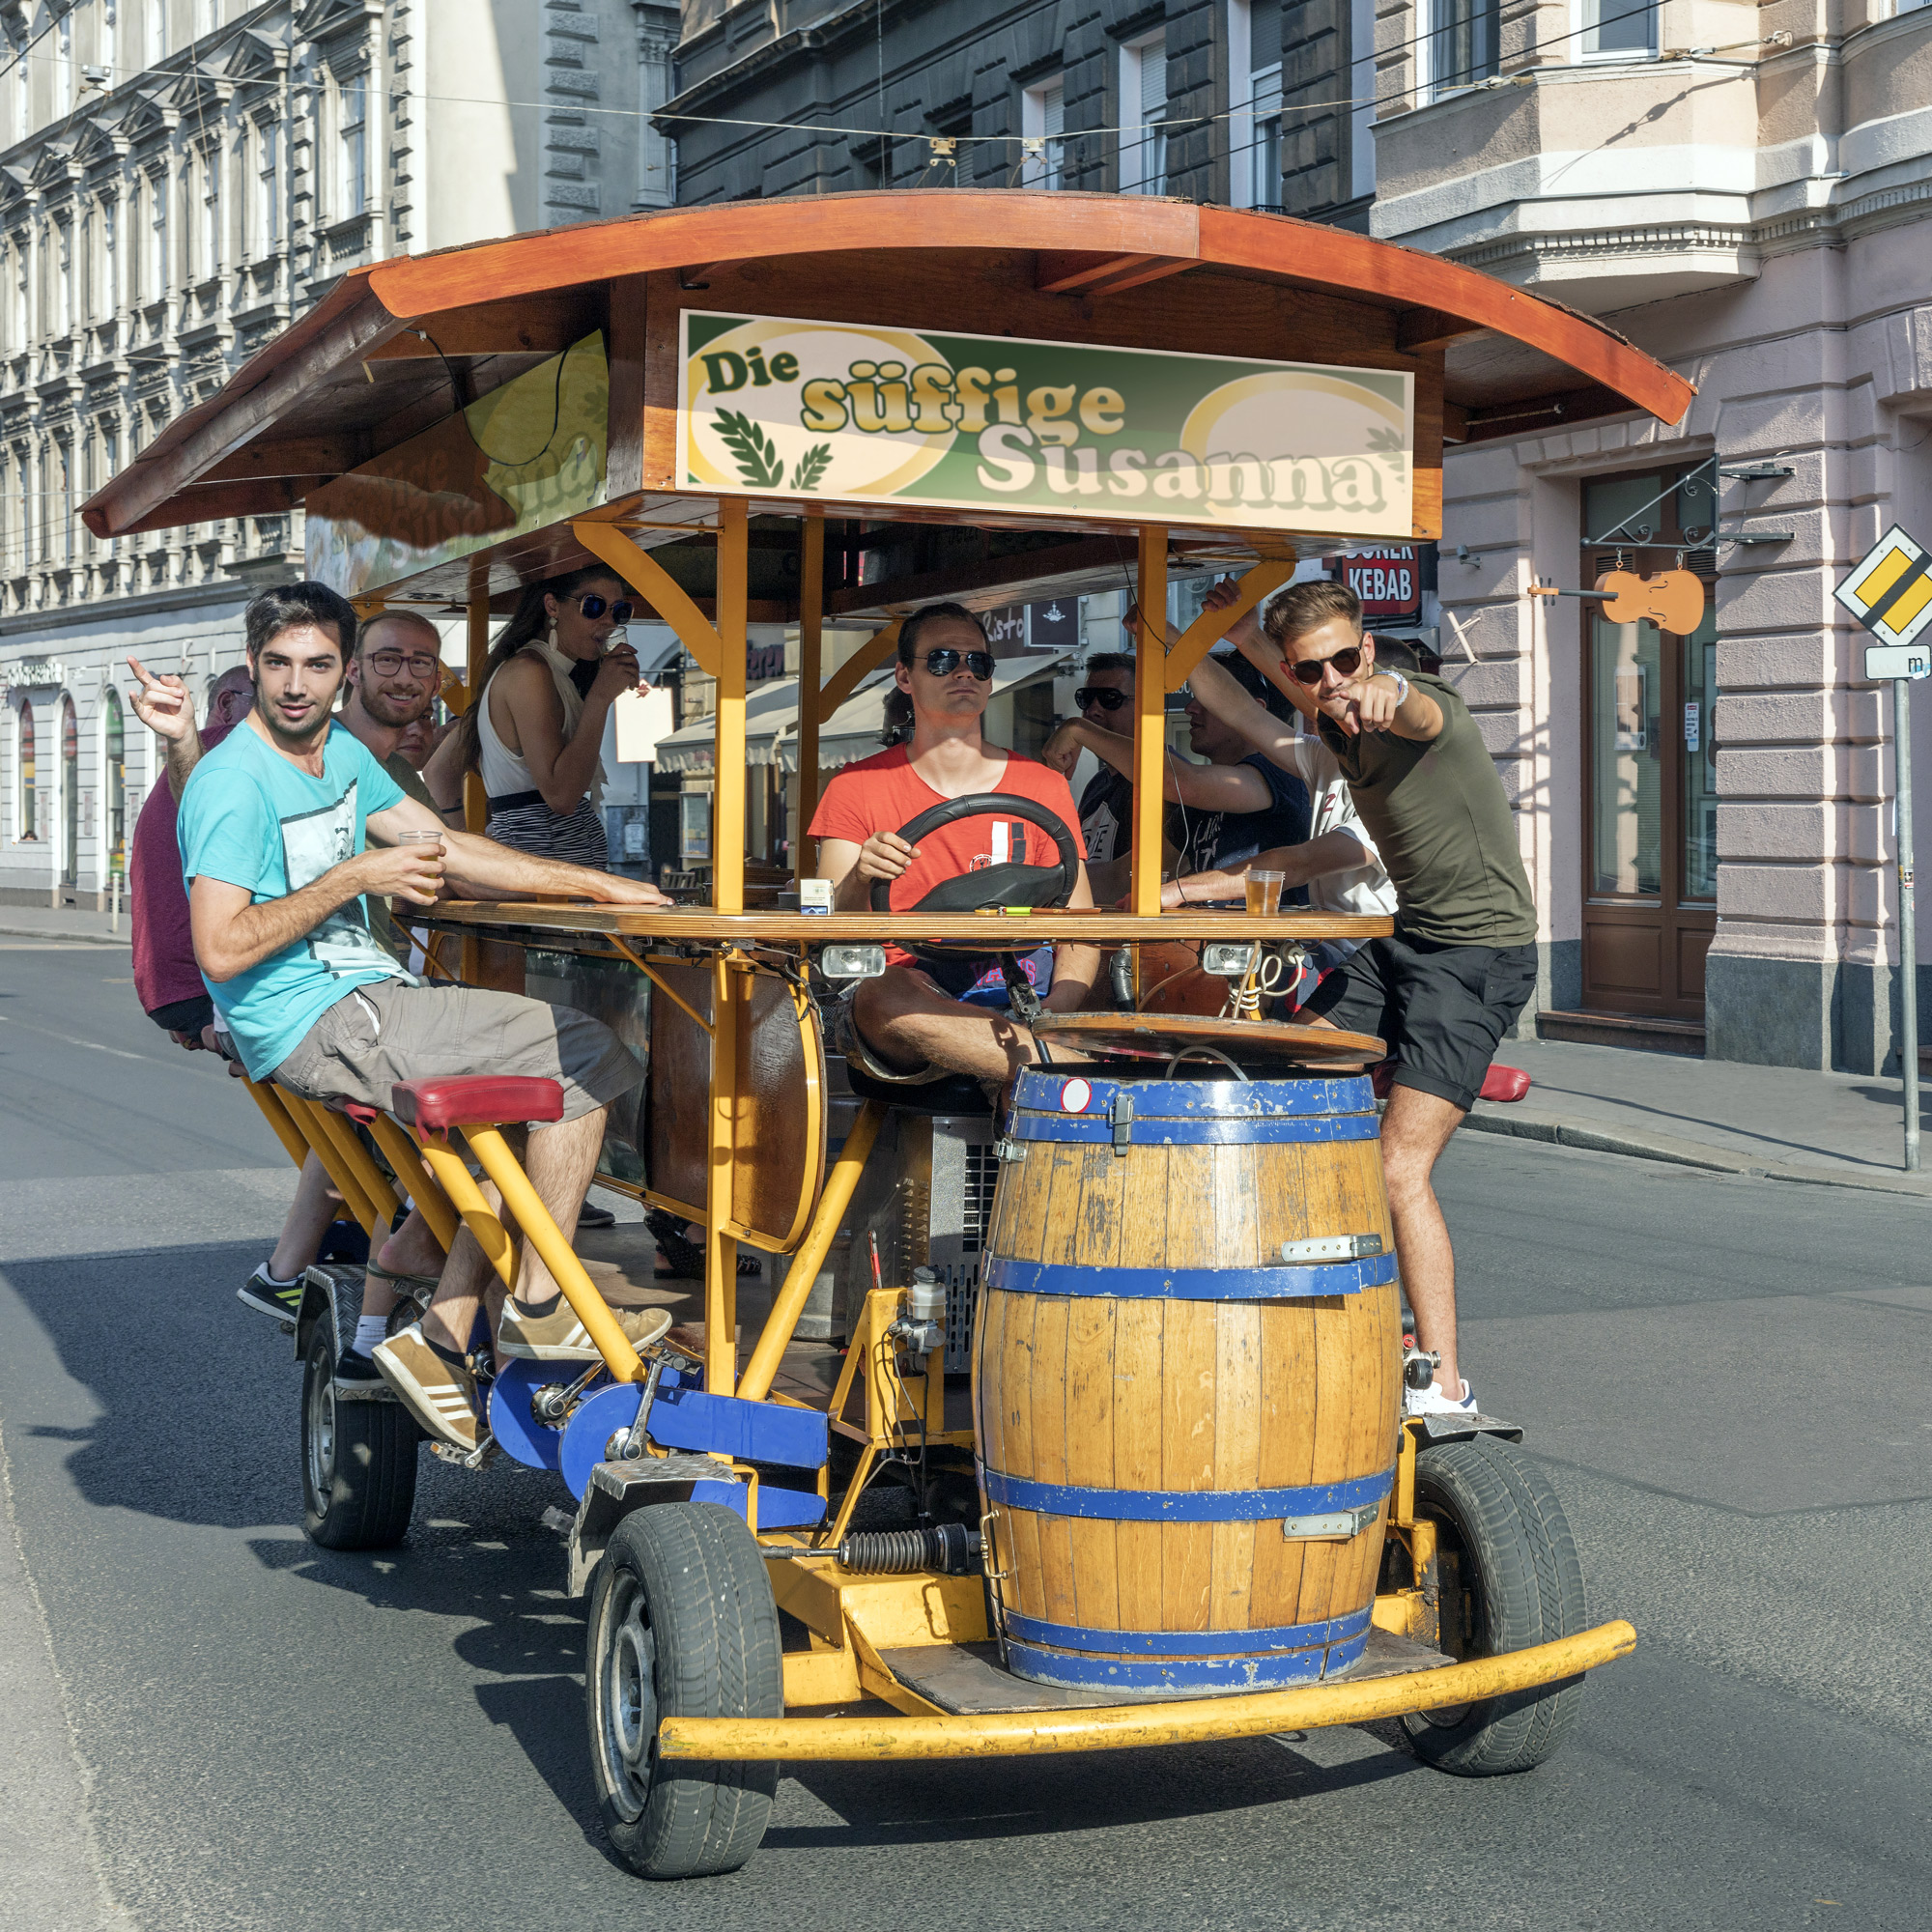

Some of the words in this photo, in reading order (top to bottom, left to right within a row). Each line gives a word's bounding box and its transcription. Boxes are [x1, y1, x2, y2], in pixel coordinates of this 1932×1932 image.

[700, 346, 800, 394] Die
[800, 360, 1126, 447] süffige
[975, 423, 1388, 514] Susanna
[1348, 567, 1412, 601] KEBAB
